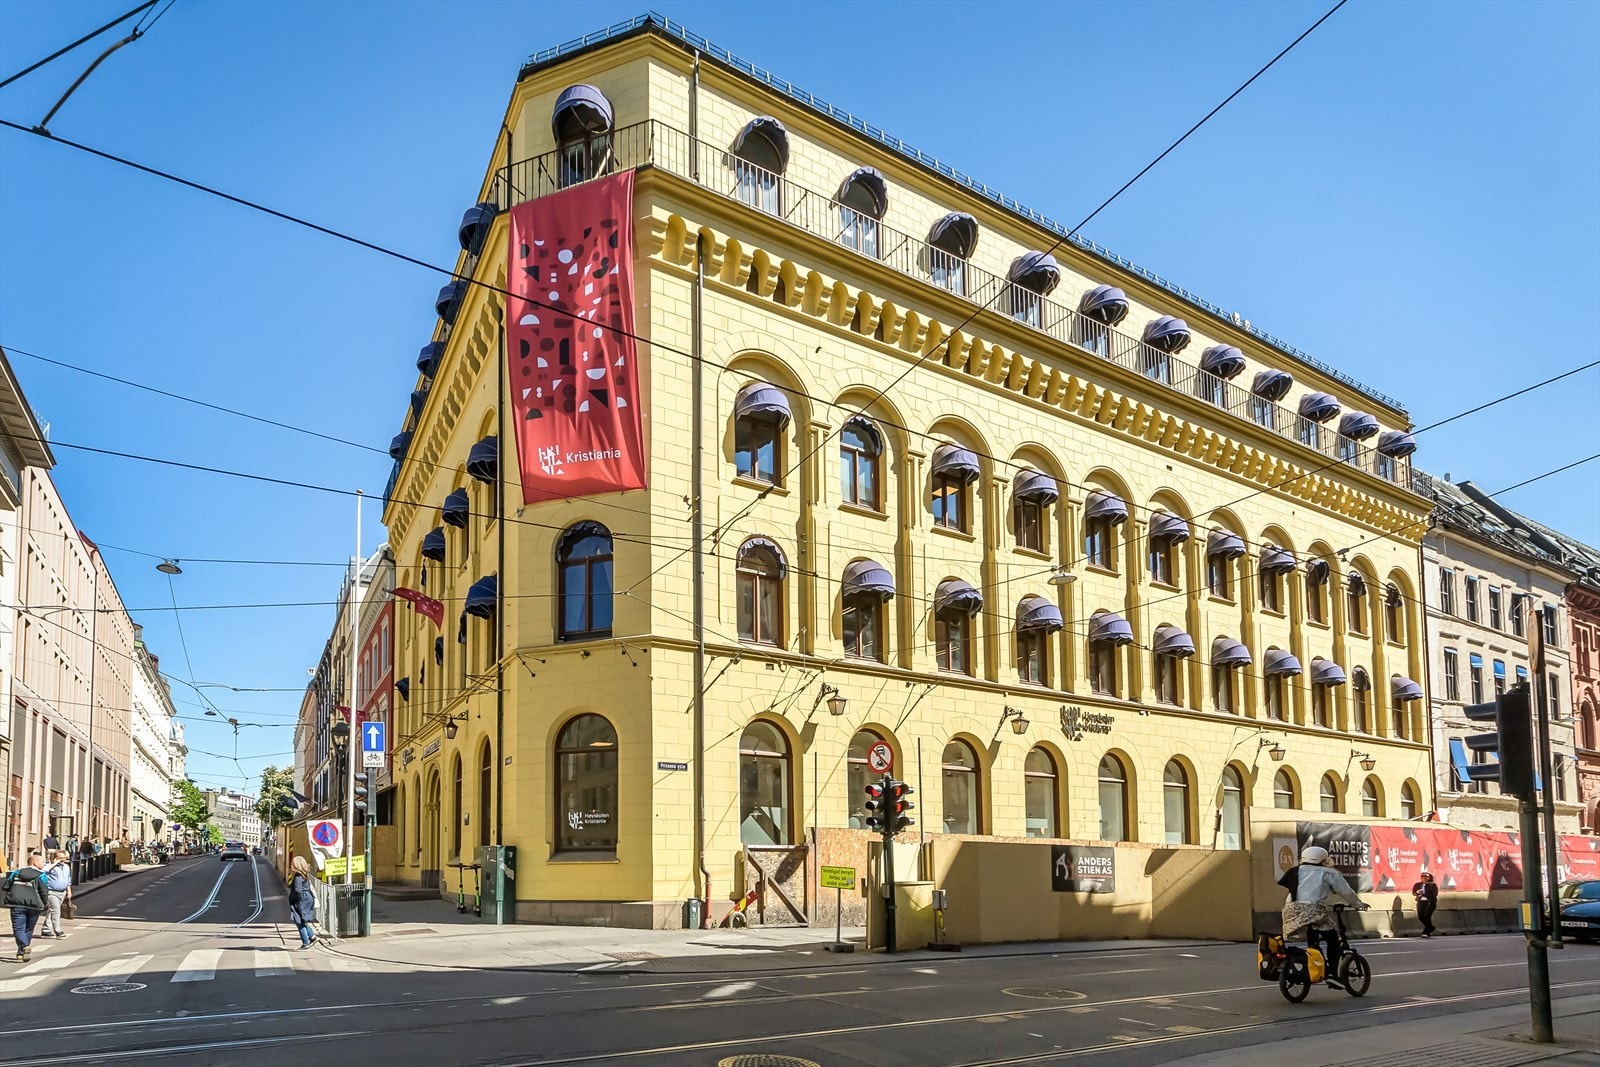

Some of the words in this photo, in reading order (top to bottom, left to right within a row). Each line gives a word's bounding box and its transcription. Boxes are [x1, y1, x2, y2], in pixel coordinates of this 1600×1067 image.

[566, 448, 621, 464] Kristiania
[1328, 840, 1369, 854] ANDERS
[1077, 857, 1112, 866] ANDERS
[1356, 854, 1369, 867] AS
[1077, 865, 1101, 875] STIEN
[1101, 866, 1113, 875] AS
